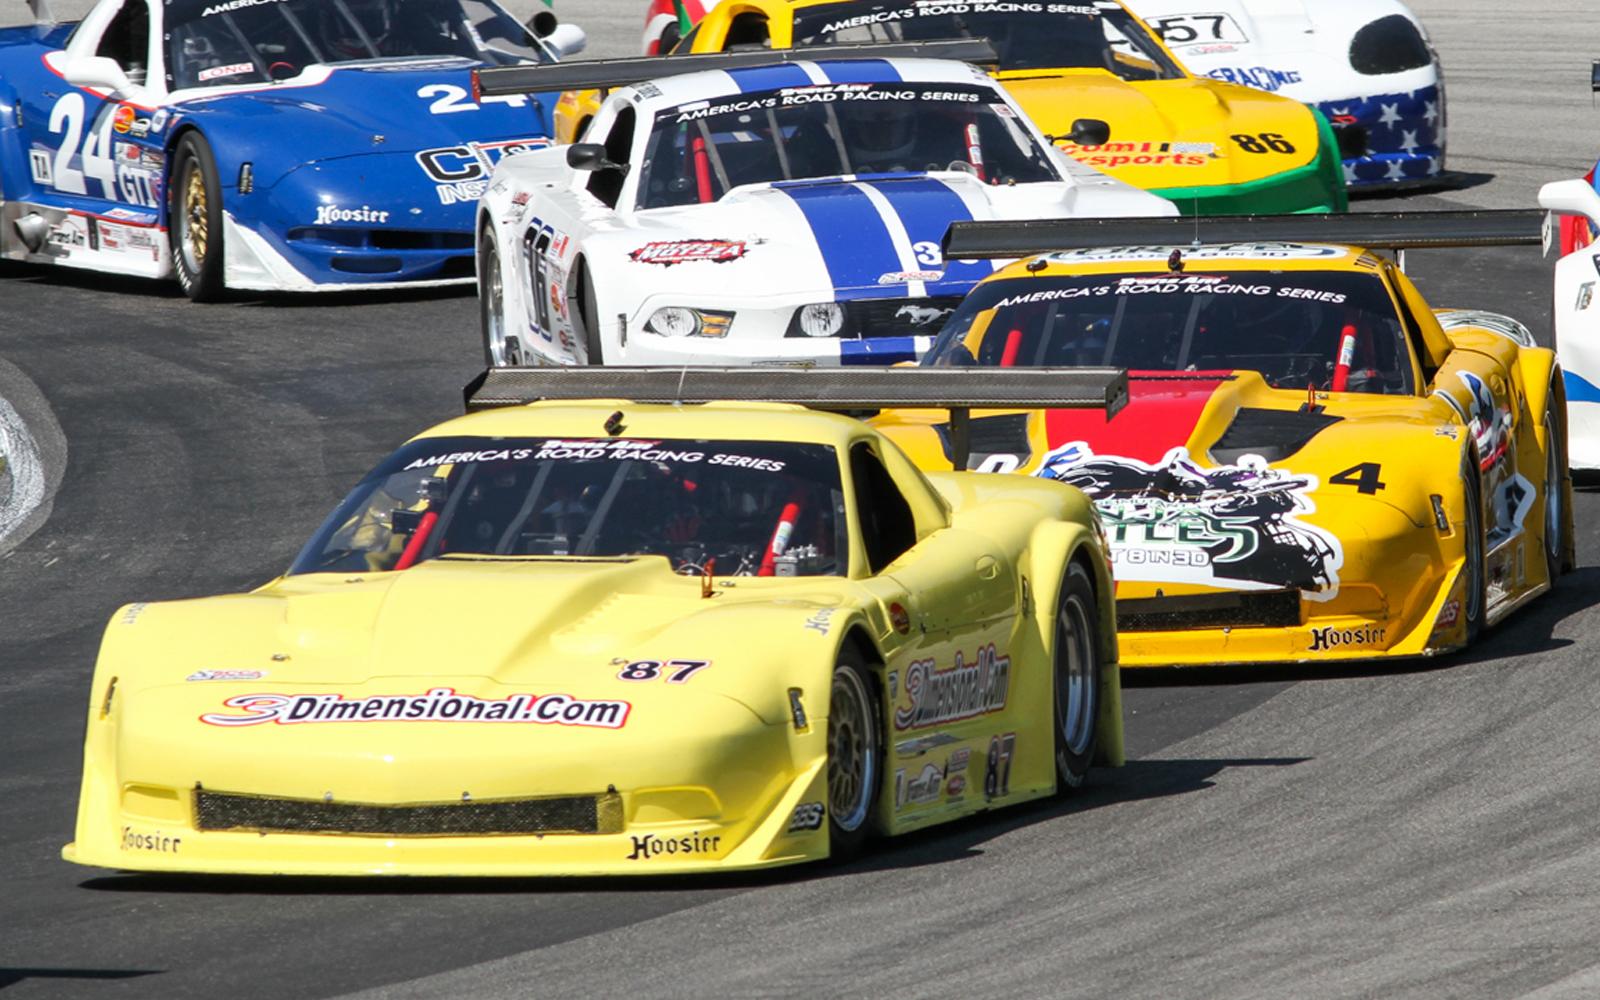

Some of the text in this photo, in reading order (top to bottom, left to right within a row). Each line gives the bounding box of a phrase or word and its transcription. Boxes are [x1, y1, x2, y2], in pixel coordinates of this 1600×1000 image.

[821, 8, 914, 34] AMERICA'S
[919, 4, 970, 17] ROAD
[974, 3, 1043, 13] RACING
[1047, 4, 1102, 16] SERIES
[1157, 15, 1225, 43] 57
[676, 90, 980, 124] AMERICA'S ROAD RACING SERIES
[48, 91, 118, 204] 24
[1229, 132, 1298, 155] 86
[313, 204, 390, 225] Hoosier
[992, 283, 1347, 310] AMERICA'S ROAD RACING SERIES
[403, 448, 787, 473] AMERICA'S ROAD RACING SERIES
[1328, 461, 1386, 496] 4
[1308, 624, 1388, 652] Hoosier
[617, 658, 709, 683] 87
[984, 733, 1016, 802] 87
[625, 831, 721, 860] Hoosier
